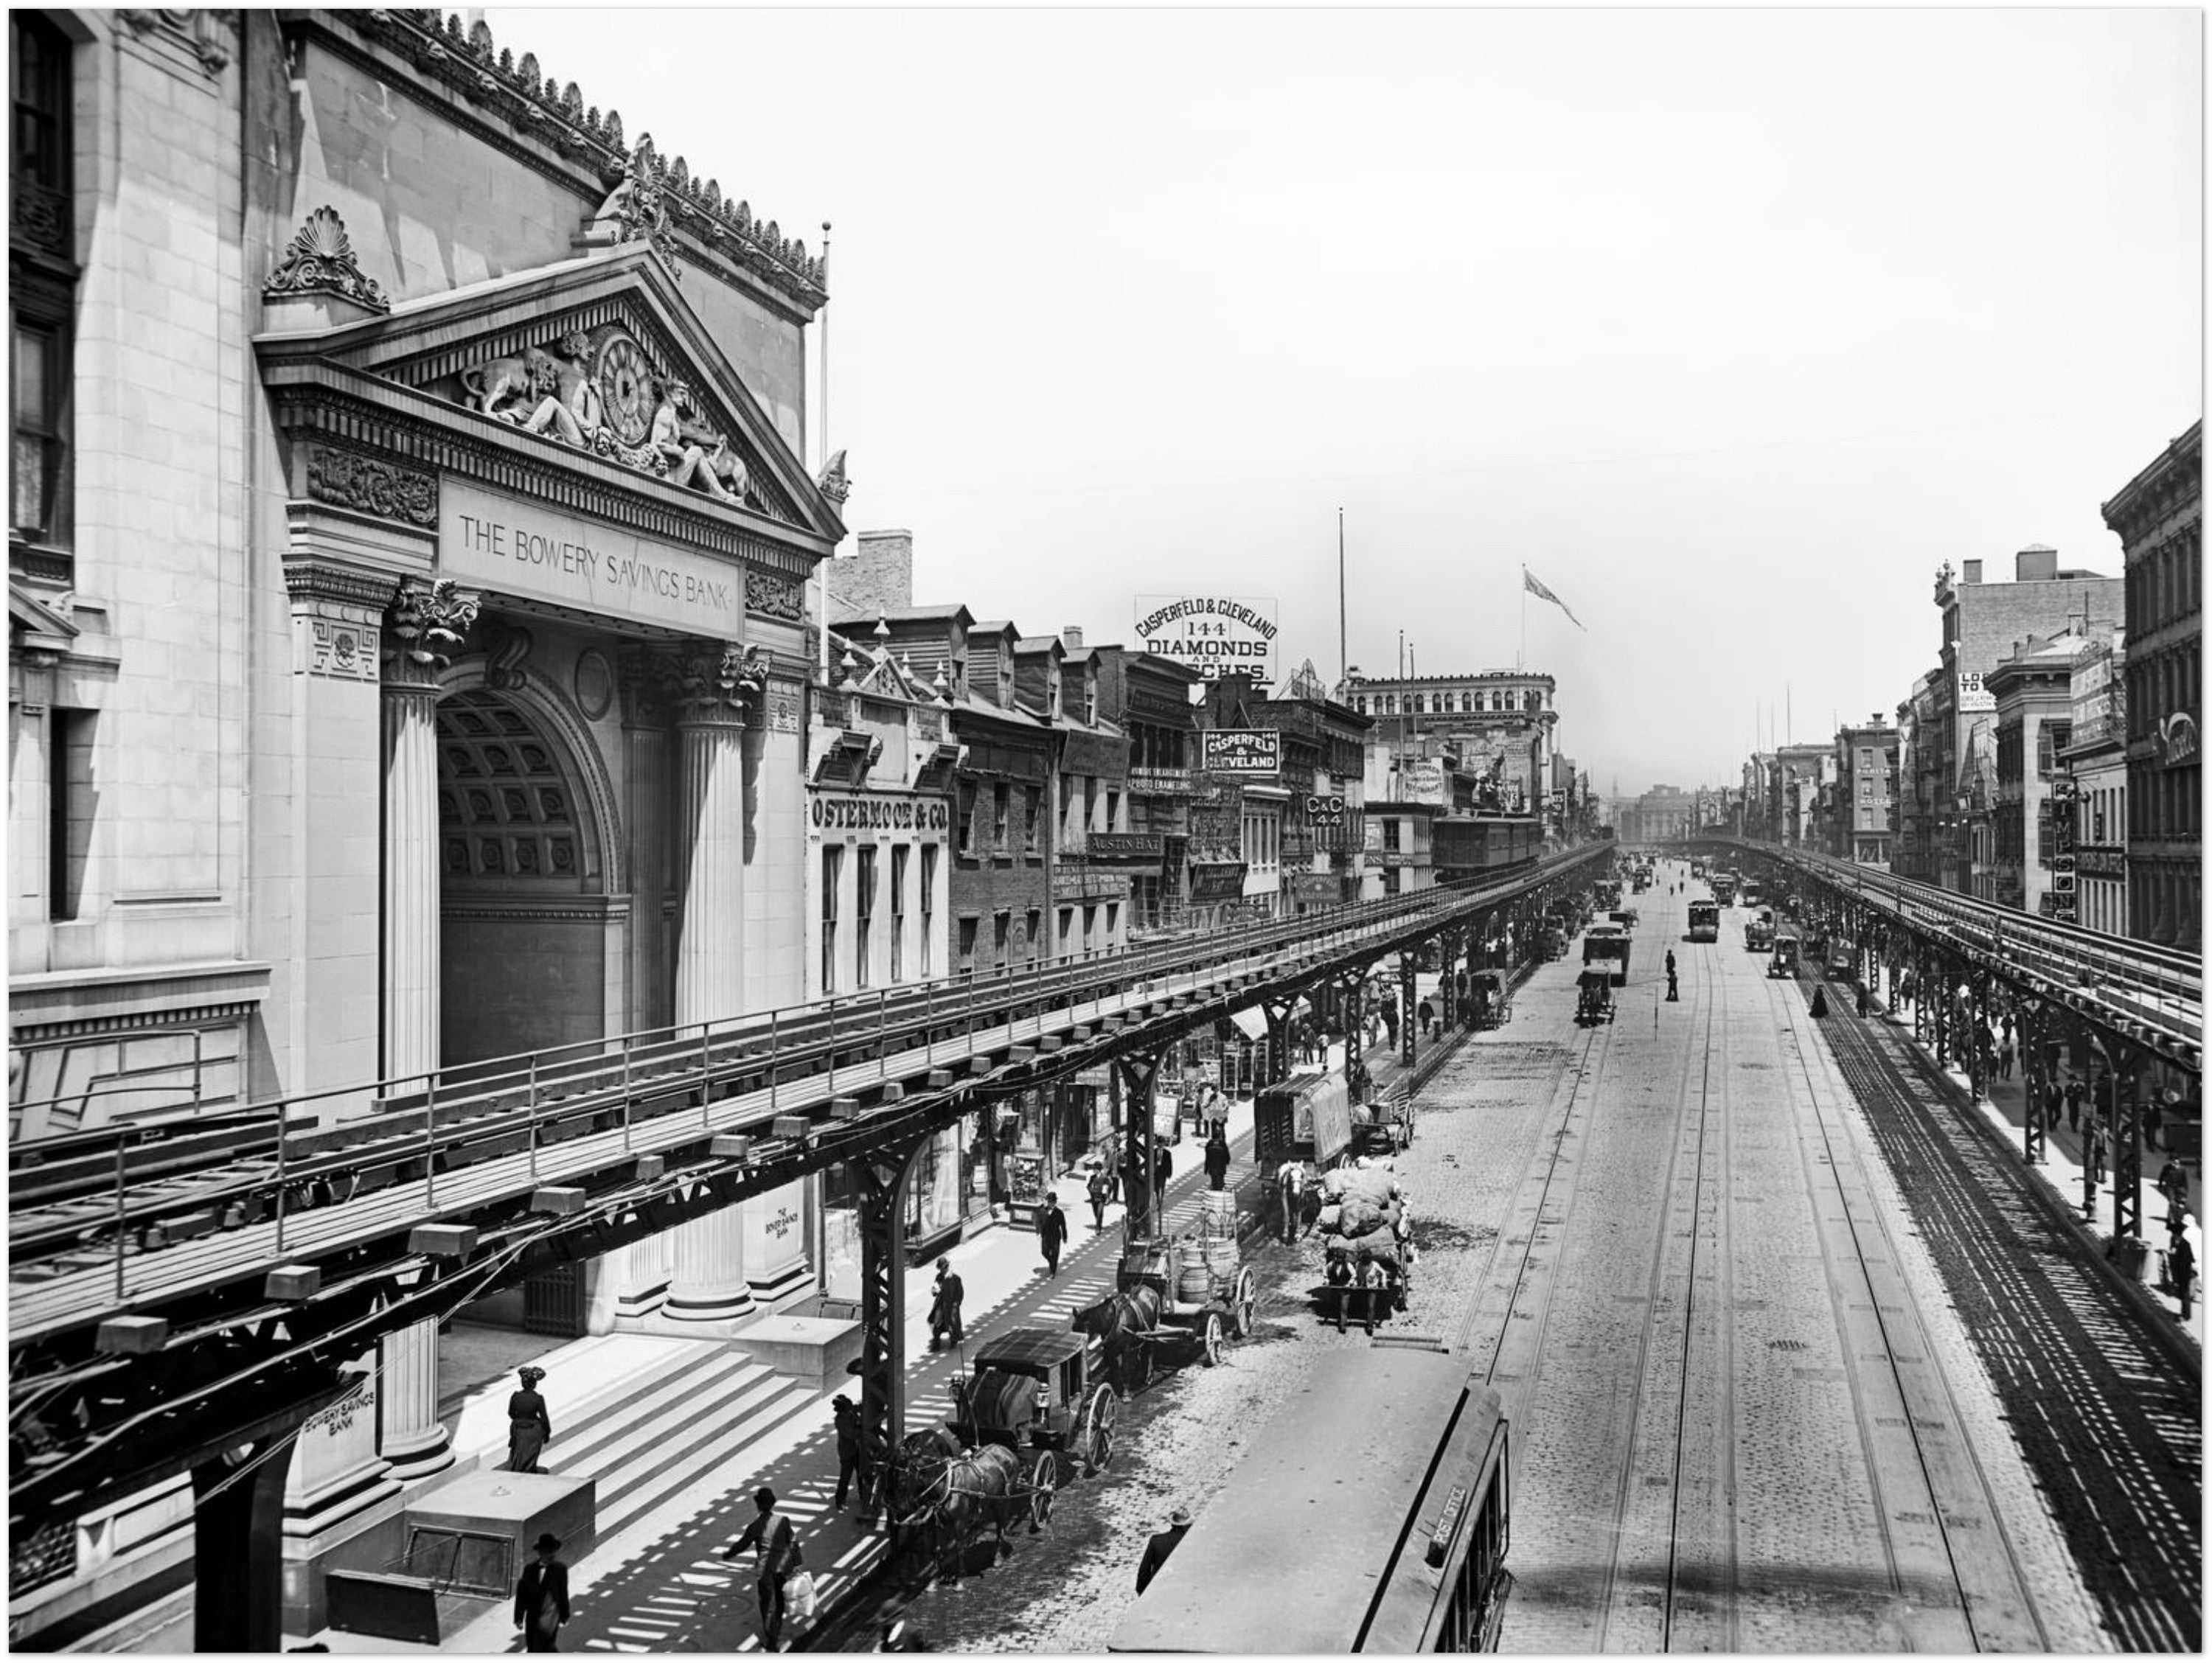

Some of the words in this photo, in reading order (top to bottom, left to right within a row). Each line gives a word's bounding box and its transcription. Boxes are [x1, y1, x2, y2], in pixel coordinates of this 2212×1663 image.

[459, 515, 506, 557] THE
[515, 529, 600, 579] BOWERY
[607, 554, 680, 599] SAVINGS
[686, 576, 728, 611] BANK
[1135, 598, 1205, 638] CASPERFELD
[1206, 598, 1216, 614] &
[1217, 599, 1278, 641] CLEVELAND
[1188, 621, 1227, 636] 144
[1146, 639, 1268, 657] DIAMONDS
[1208, 733, 1276, 753] CASPERFELD
[1236, 747, 1248, 756] &
[1207, 756, 1276, 768] CLEVELAND
[812, 798, 912, 830] OSTERMOOR
[914, 802, 927, 831] &
[1309, 814, 1342, 826] 144
[1092, 836, 1133, 851] AUSTIN
[1135, 837, 1160, 851] HAT
[340, 1391, 375, 1417] SAVINGS
[329, 1416, 353, 1437] BANK
[1434, 1518, 1453, 1544] POST
